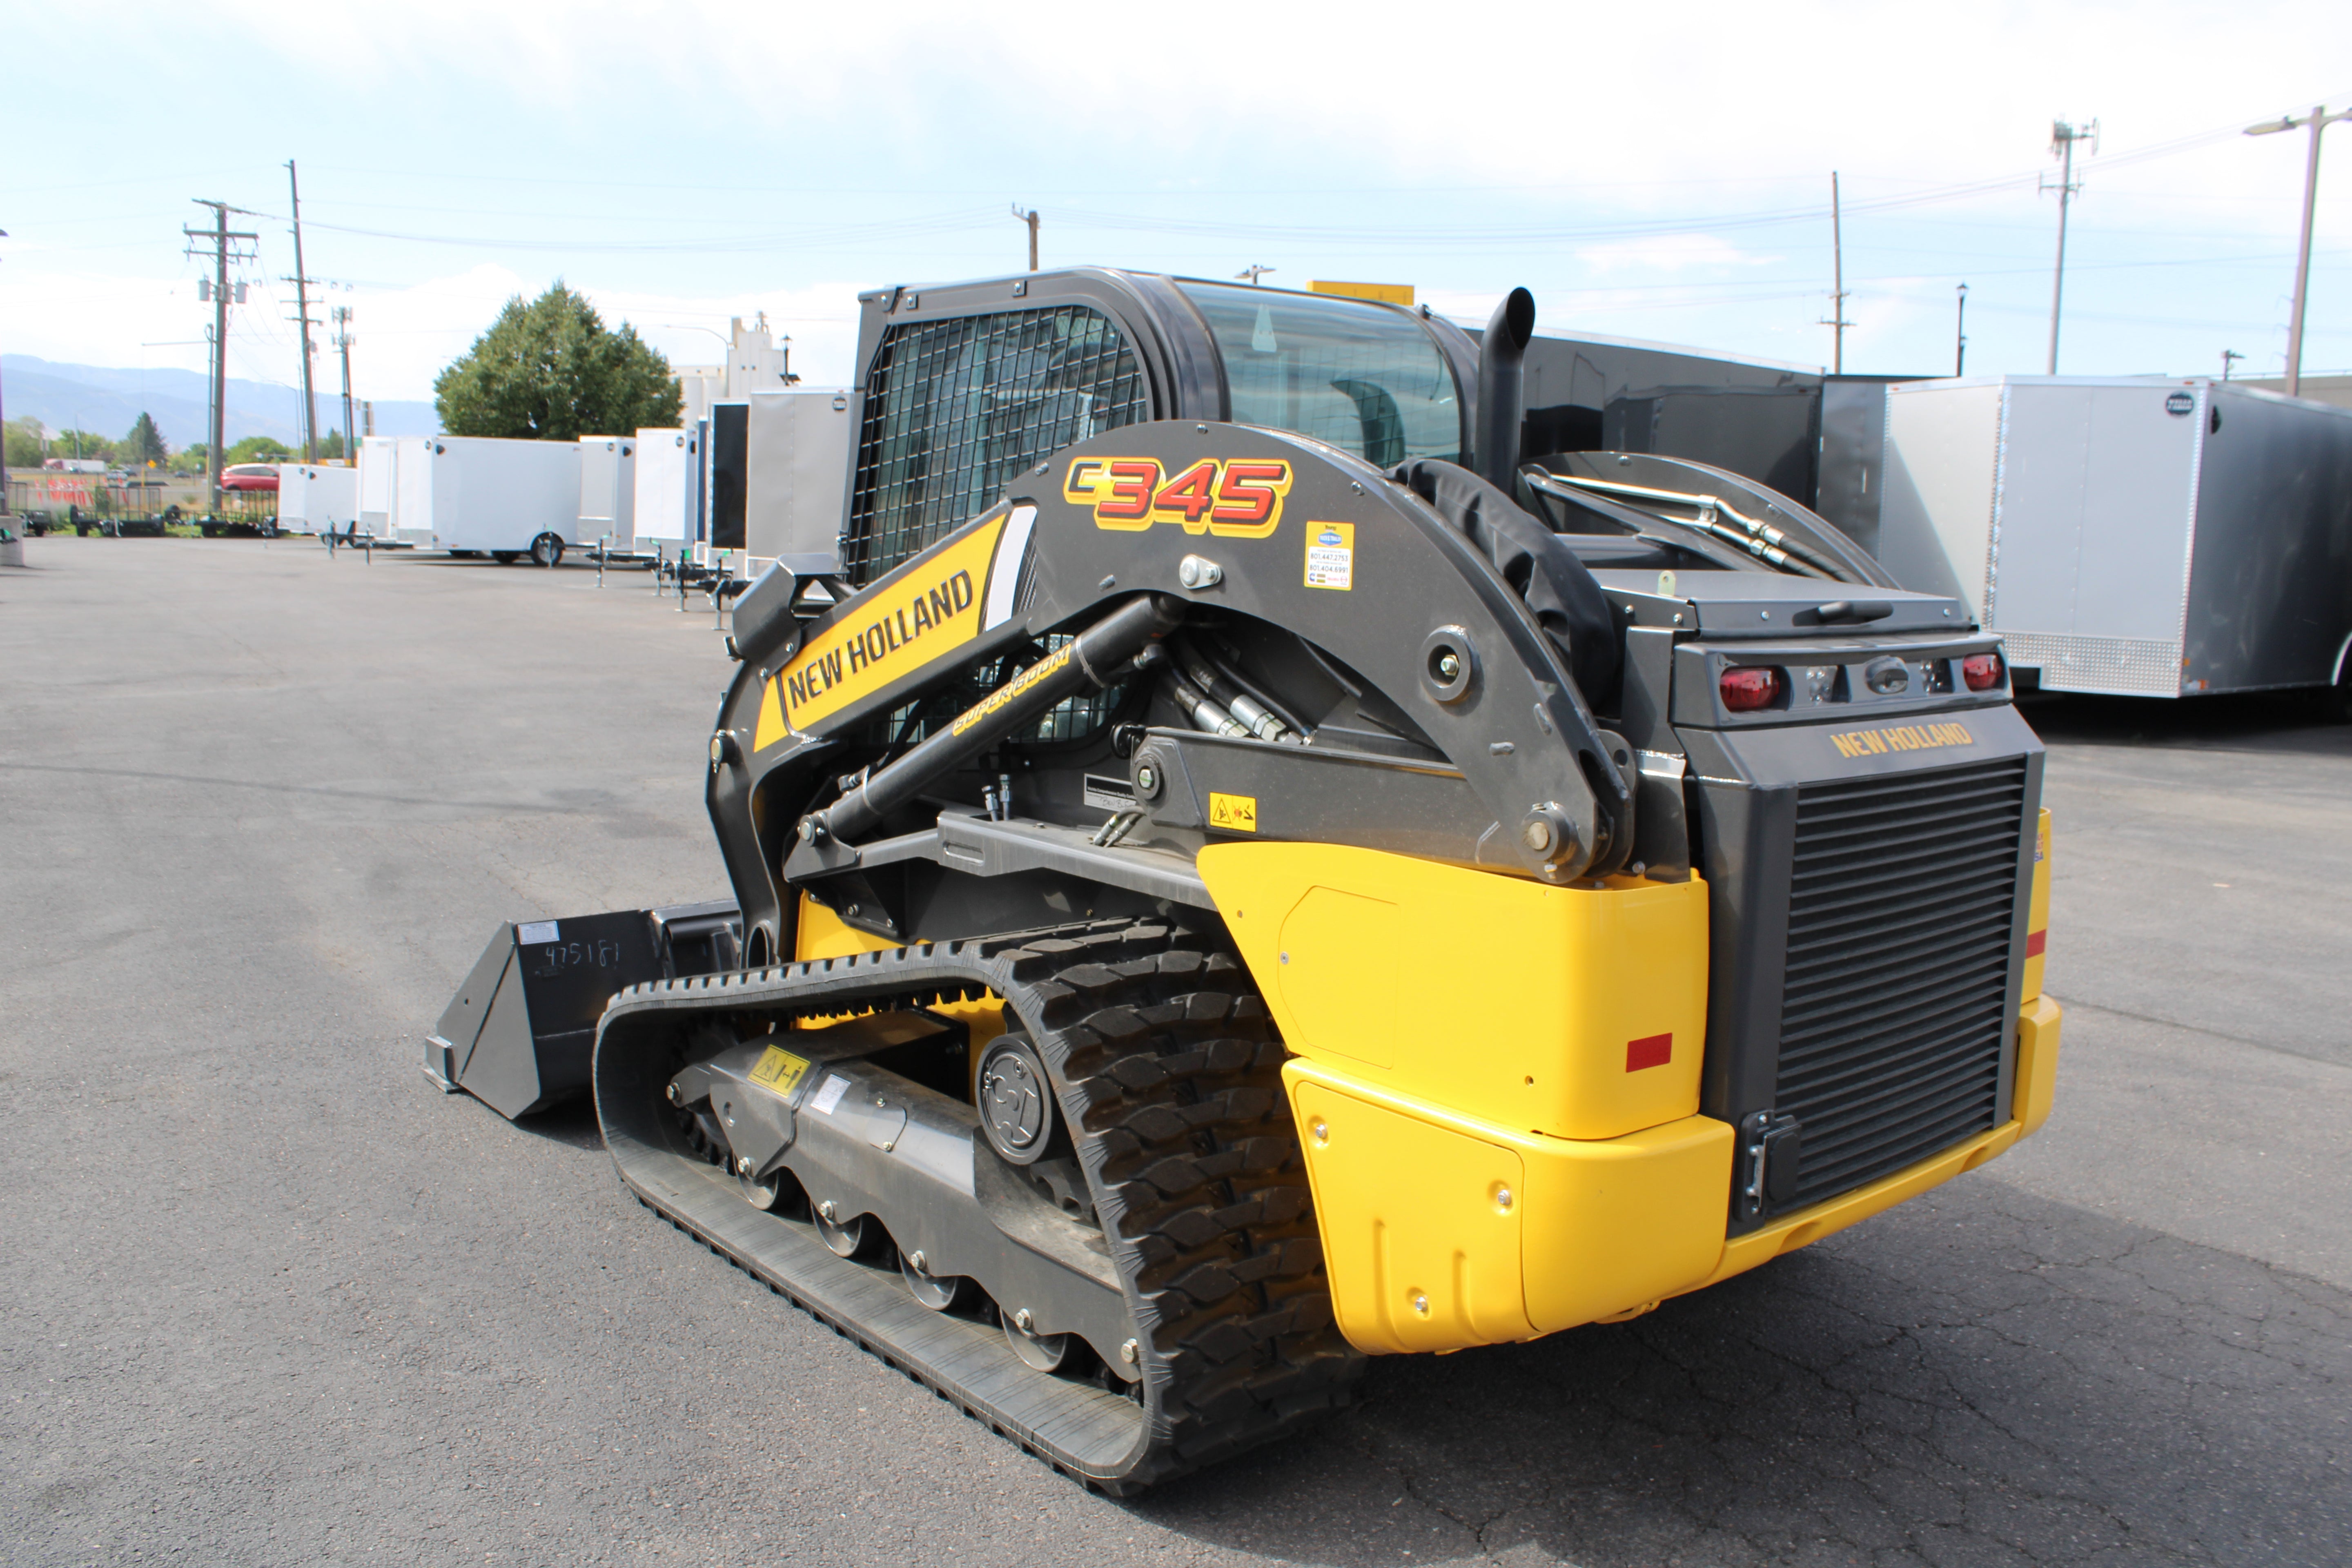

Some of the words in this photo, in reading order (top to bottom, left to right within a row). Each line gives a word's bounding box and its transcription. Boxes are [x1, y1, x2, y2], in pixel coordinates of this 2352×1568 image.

[1064, 457, 1293, 537] C345
[1309, 564, 1348, 574] 801.404.6991
[1310, 552, 1348, 562] 801.447.2753
[787, 646, 843, 710] NEW
[846, 569, 973, 675] HOLLAND
[953, 682, 1013, 736] SUPER
[1013, 644, 1071, 697] BOOM
[1830, 730, 1888, 758] NEW
[1880, 722, 1973, 752] HOLLAND
[546, 940, 619, 967] 475181
